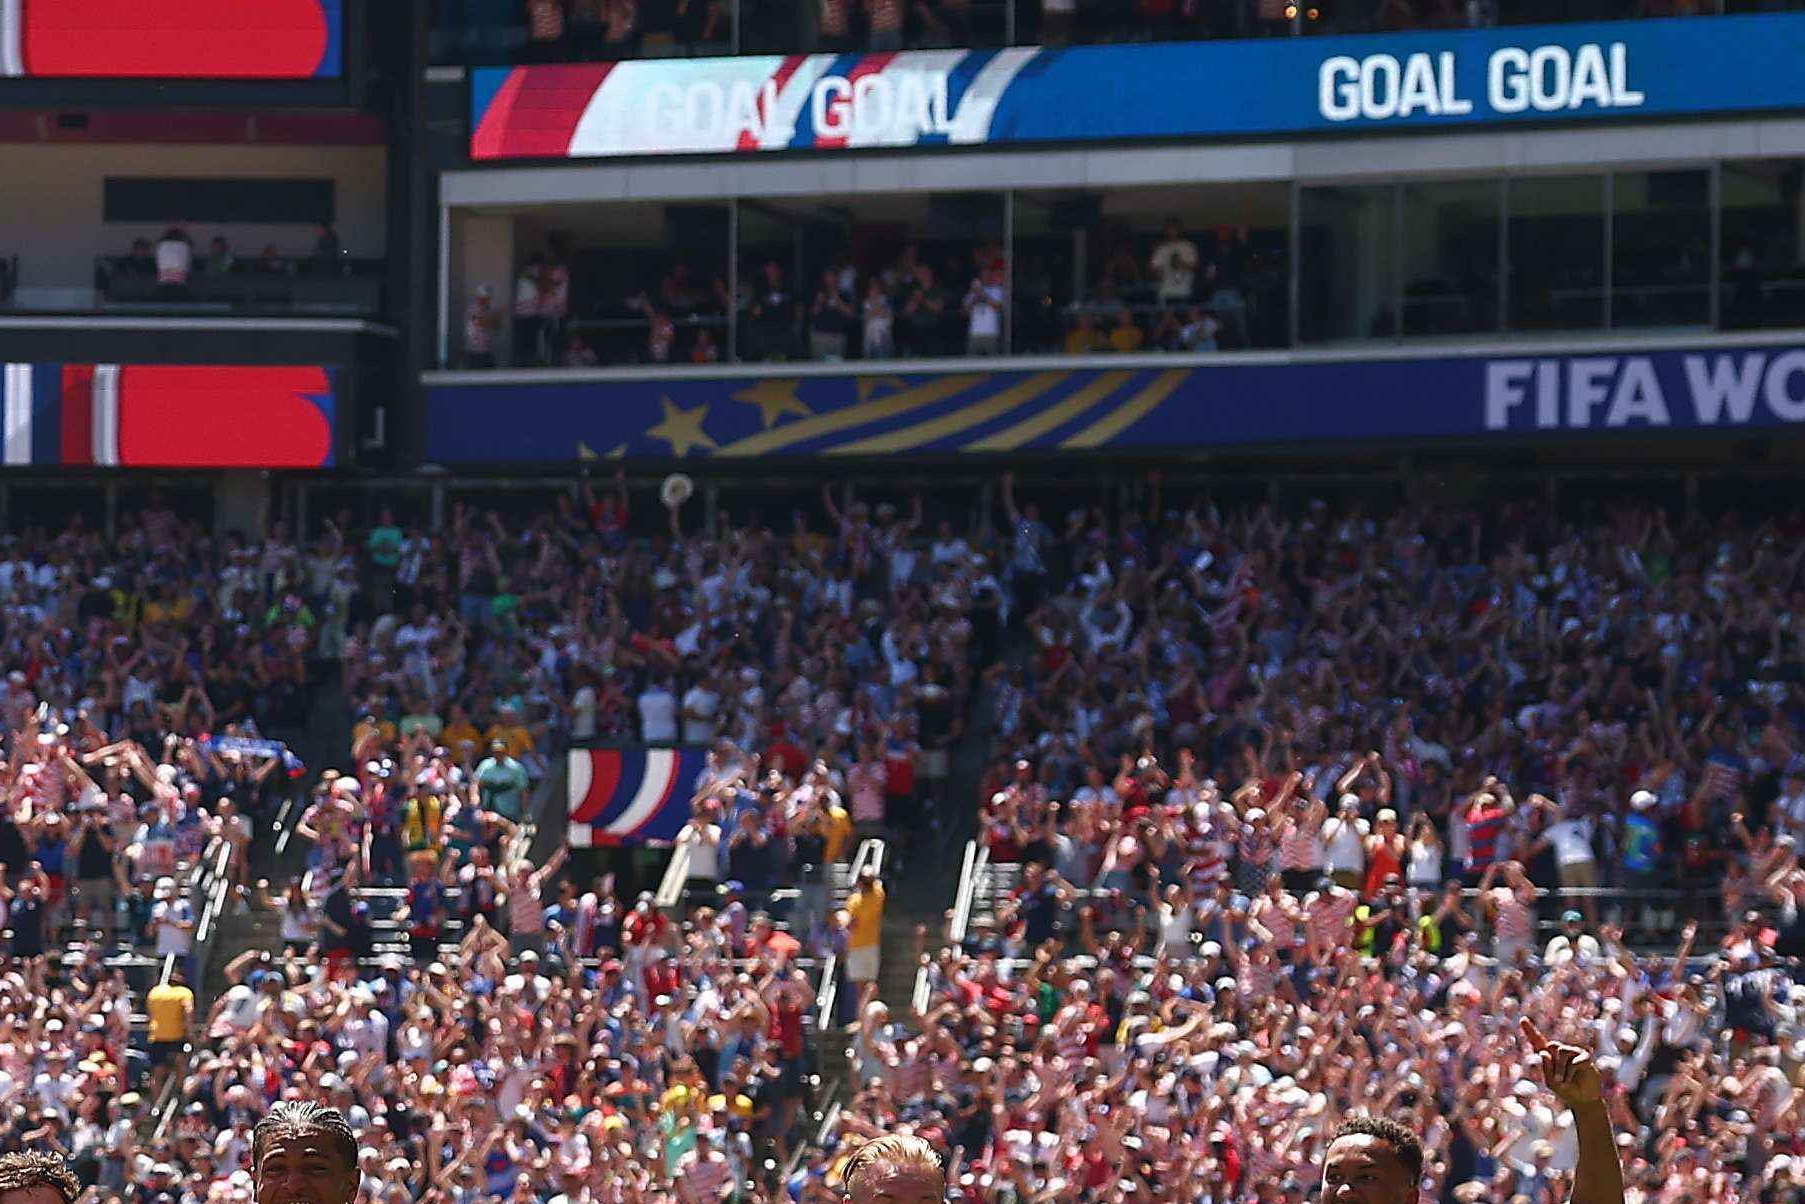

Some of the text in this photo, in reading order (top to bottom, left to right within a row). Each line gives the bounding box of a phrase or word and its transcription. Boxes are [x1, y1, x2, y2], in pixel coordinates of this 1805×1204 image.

[647, 71, 962, 140] GOAL GOAL
[1319, 42, 1645, 121] GOAL GOAL
[1485, 357, 1672, 430] FIFA
